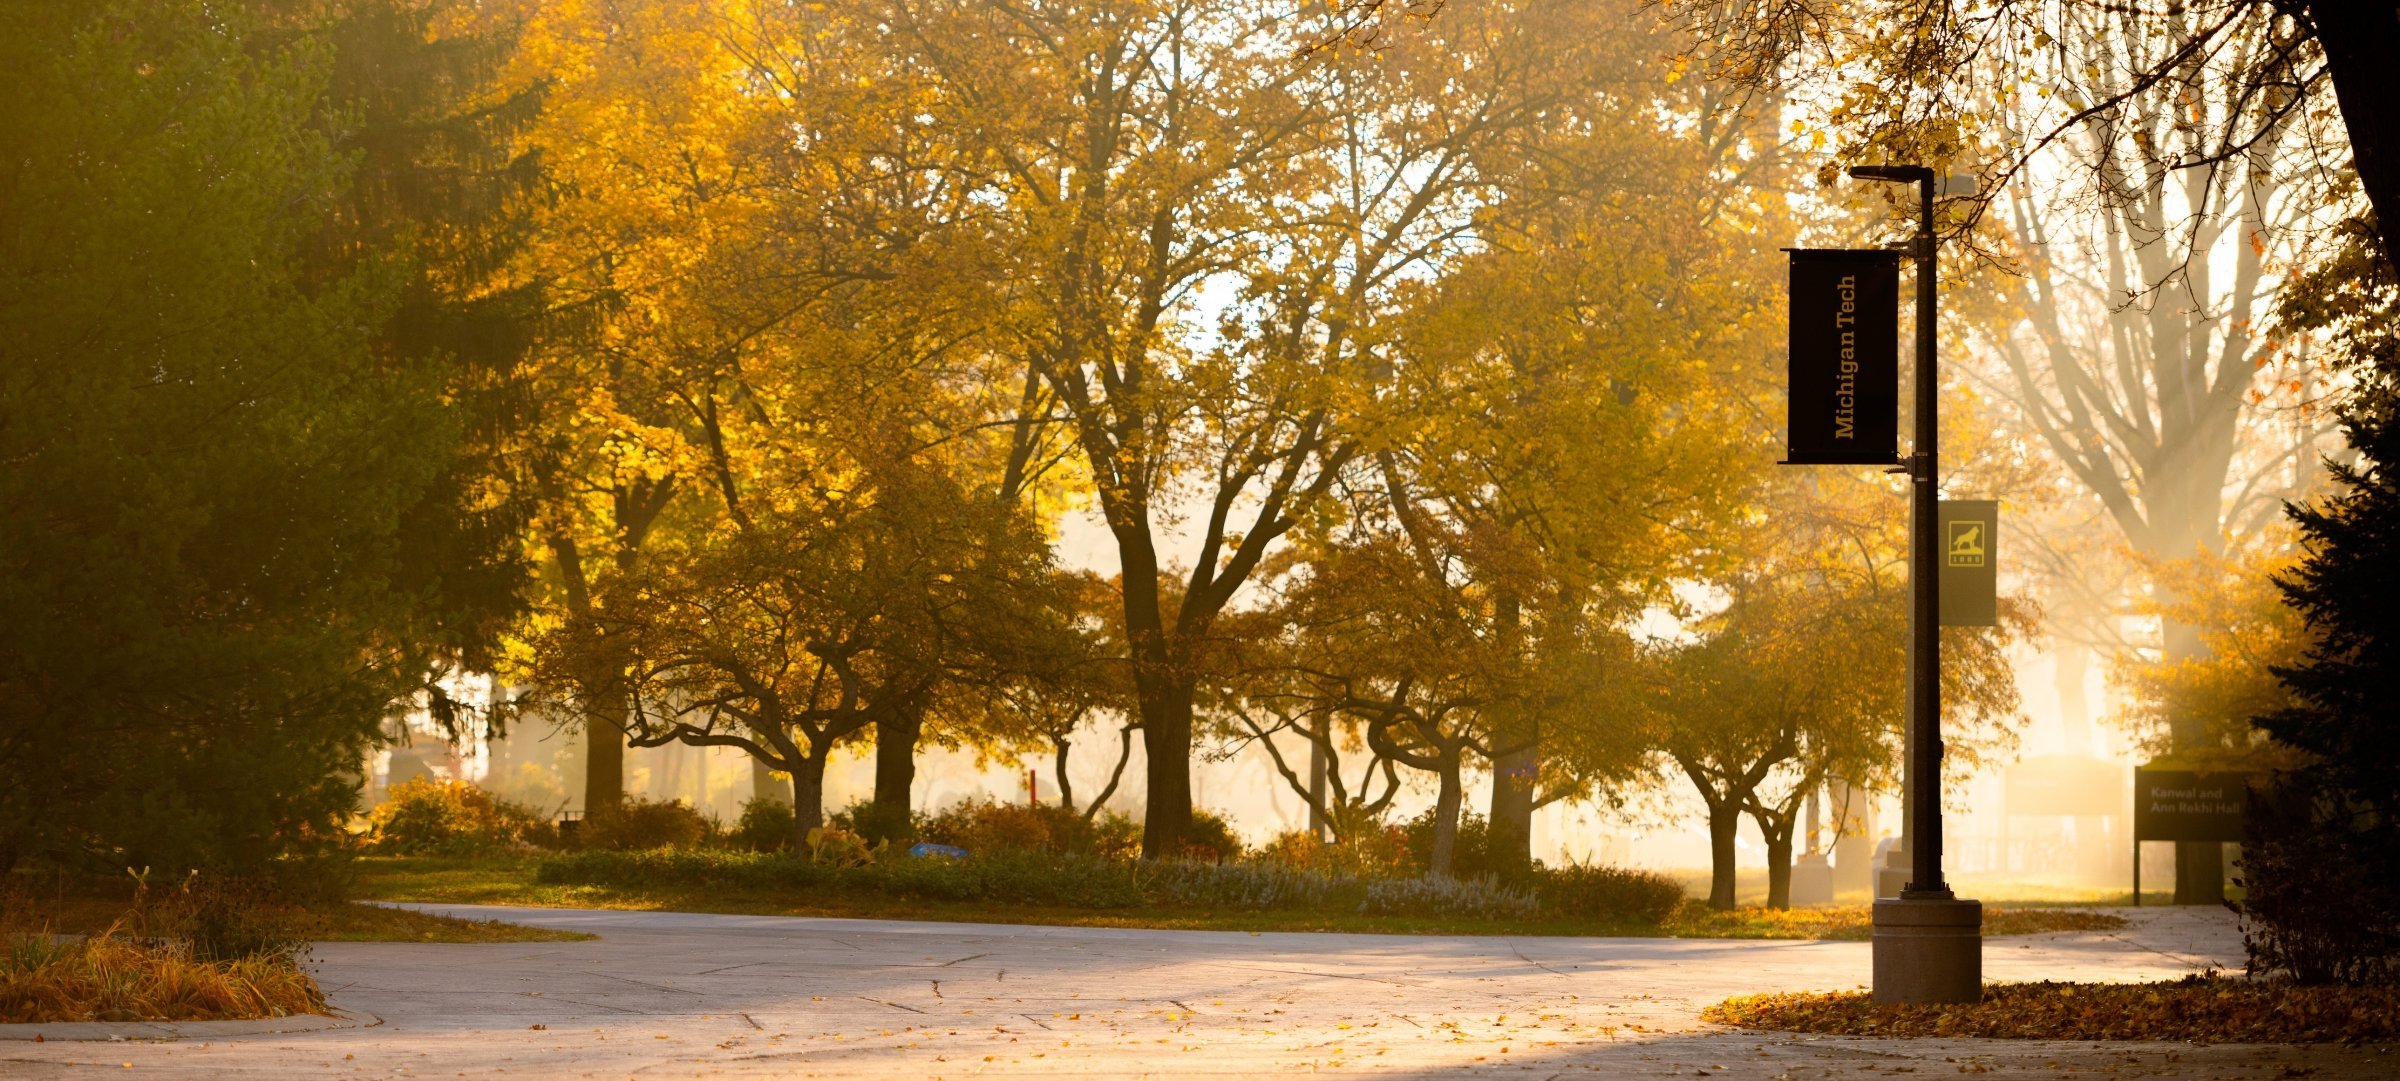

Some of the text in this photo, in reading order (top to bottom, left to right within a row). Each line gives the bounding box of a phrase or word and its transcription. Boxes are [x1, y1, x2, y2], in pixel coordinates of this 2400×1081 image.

[1836, 275, 1858, 439] Michigan Tech
[2151, 787, 2223, 799] Kanwal and
[2151, 802, 2240, 814] Ann Rekhi Hall
